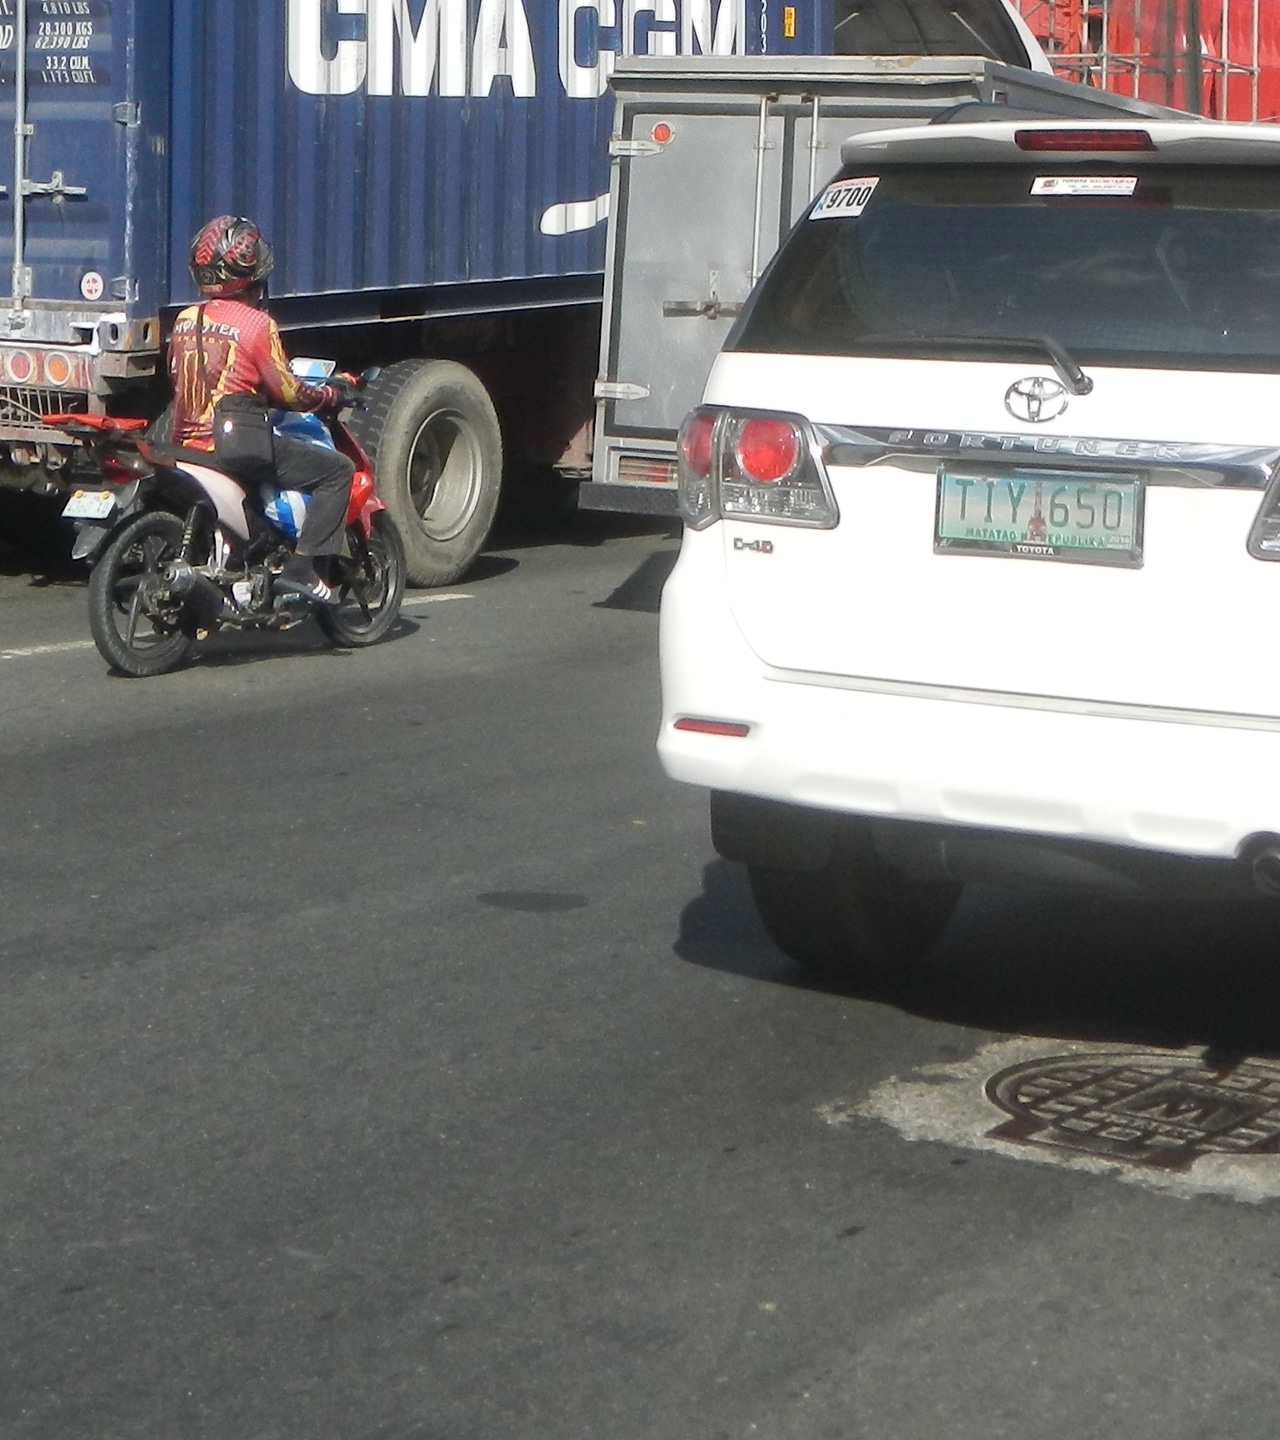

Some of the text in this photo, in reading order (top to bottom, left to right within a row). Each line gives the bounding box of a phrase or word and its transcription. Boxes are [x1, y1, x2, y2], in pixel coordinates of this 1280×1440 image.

[70, 2, 90, 15] LBS
[38, 22, 93, 36] 28.300 KGS
[72, 36, 90, 49] LBS
[46, 56, 66, 70] 33.2
[826, 186, 872, 209] 9700
[178, 335, 224, 345] ENEGY
[886, 429, 1183, 460] FORTUNER
[1049, 485, 1124, 531] 650
[1048, 533, 1105, 548] EPUBLIKA
[1016, 544, 1054, 555] TOYOTA
